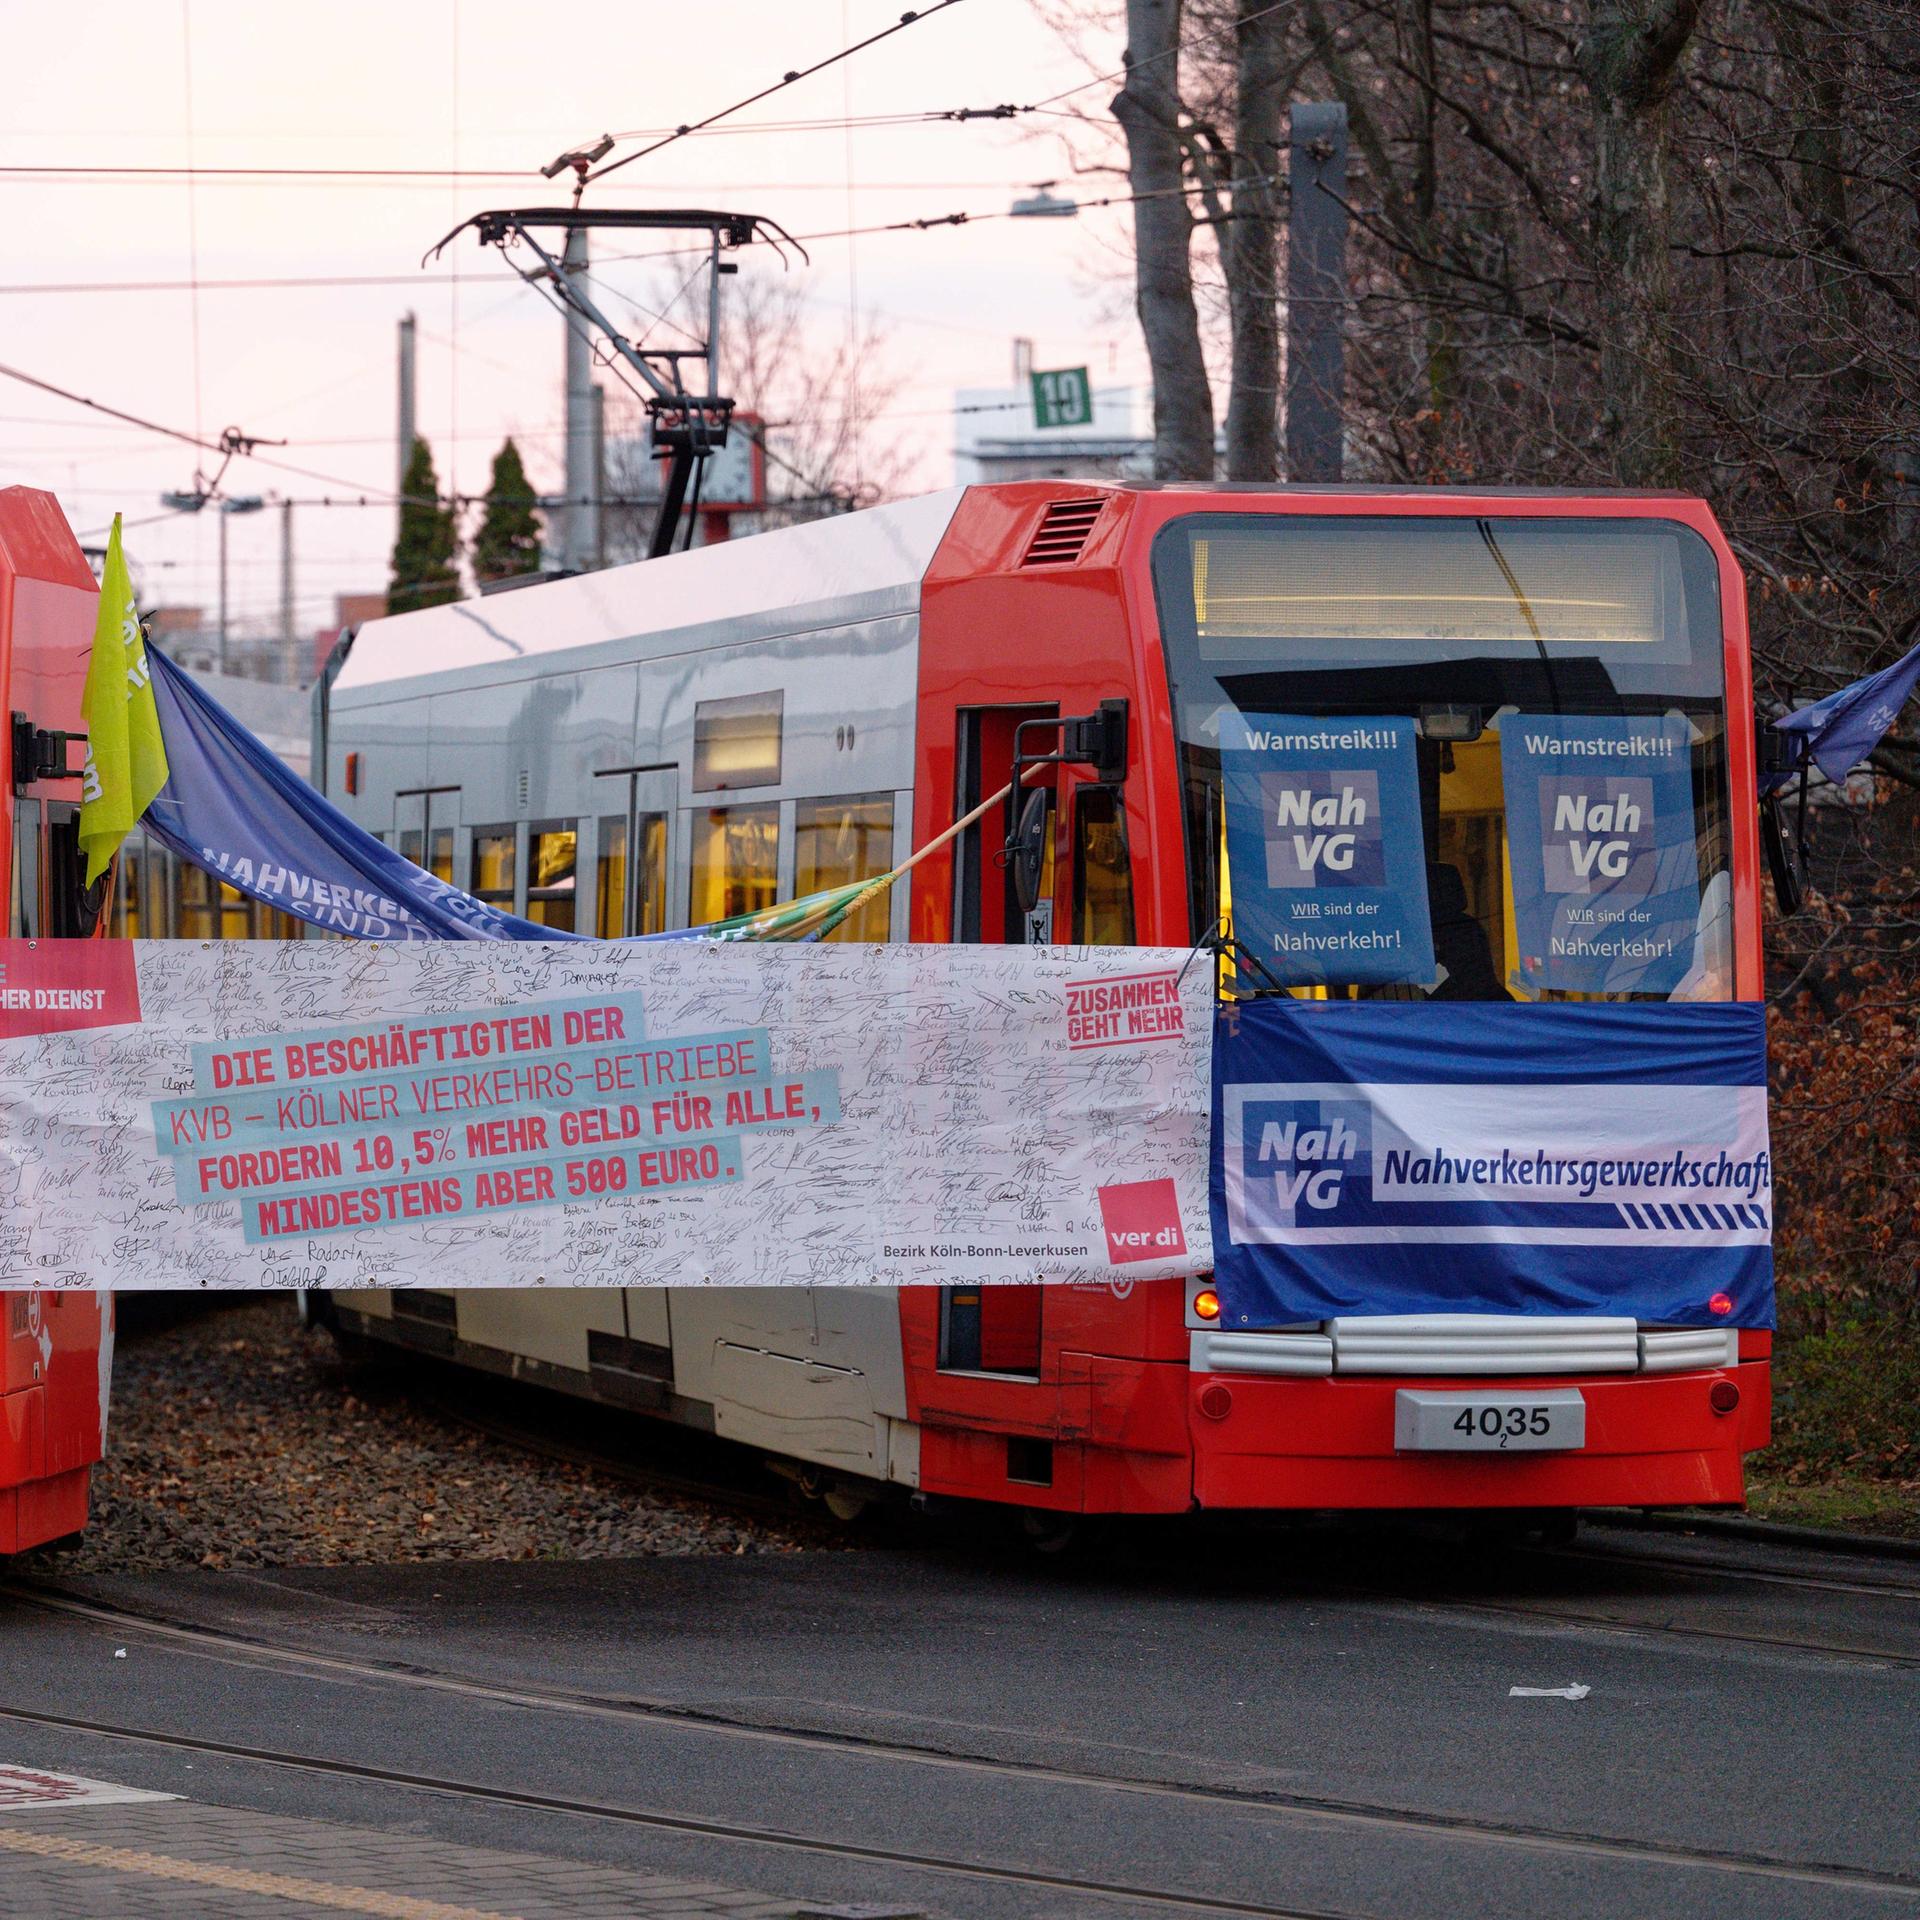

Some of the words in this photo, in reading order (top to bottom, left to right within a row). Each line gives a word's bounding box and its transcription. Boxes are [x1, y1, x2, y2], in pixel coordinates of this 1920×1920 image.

[1245, 730, 1397, 750] Warnstreik!!!
[1525, 735, 1672, 756] Warnstreik!!!
[1277, 787, 1366, 827] Nah
[1554, 794, 1641, 832] Nah
[1293, 834, 1355, 871] VG
[1569, 840, 1630, 877] VG
[1291, 902, 1321, 918] WIR
[1324, 902, 1352, 915] sind
[1355, 902, 1379, 915] der
[1567, 909, 1595, 923] WIR
[1598, 910, 1625, 922] sind
[1629, 910, 1651, 922] der
[1274, 930, 1401, 951] Nahverkehr!
[1552, 937, 1672, 957] Nahverkehr!
[35, 989, 105, 1010] DIENST
[1066, 978, 1179, 1016] ZUSAMMEN
[1068, 1012, 1121, 1042] GEHT
[1128, 1006, 1185, 1035] MEHR
[212, 1048, 275, 1089] DIE
[285, 1014, 553, 1080] BESCHÄFTIGTEN
[563, 1006, 625, 1045] DER
[170, 1105, 232, 1145] KVB
[277, 1084, 399, 1130] KÖLNER
[198, 1140, 343, 1193] FORDERN
[465, 1115, 549, 1158] MEHR
[559, 1105, 641, 1147] GELD
[653, 1090, 713, 1135] FÜR
[725, 1083, 821, 1126] ALLE,
[1258, 1118, 1357, 1161] Nah
[257, 1177, 463, 1237] MINDESTENS
[475, 1166, 555, 1209] ABER
[565, 1156, 629, 1196] 500
[639, 1144, 736, 1187] EURO.
[1274, 1169, 1343, 1209] VG
[1383, 1147, 1769, 1199] Nahverkehrsgewerkschaft
[884, 1245, 926, 1258] Bezirk
[930, 1243, 1088, 1258] Köln-Bonn-Leverkusen
[1111, 1227, 1178, 1247] ver.di
[1453, 1407, 1550, 1436] 4035
[1500, 1433, 1508, 1448] 2
